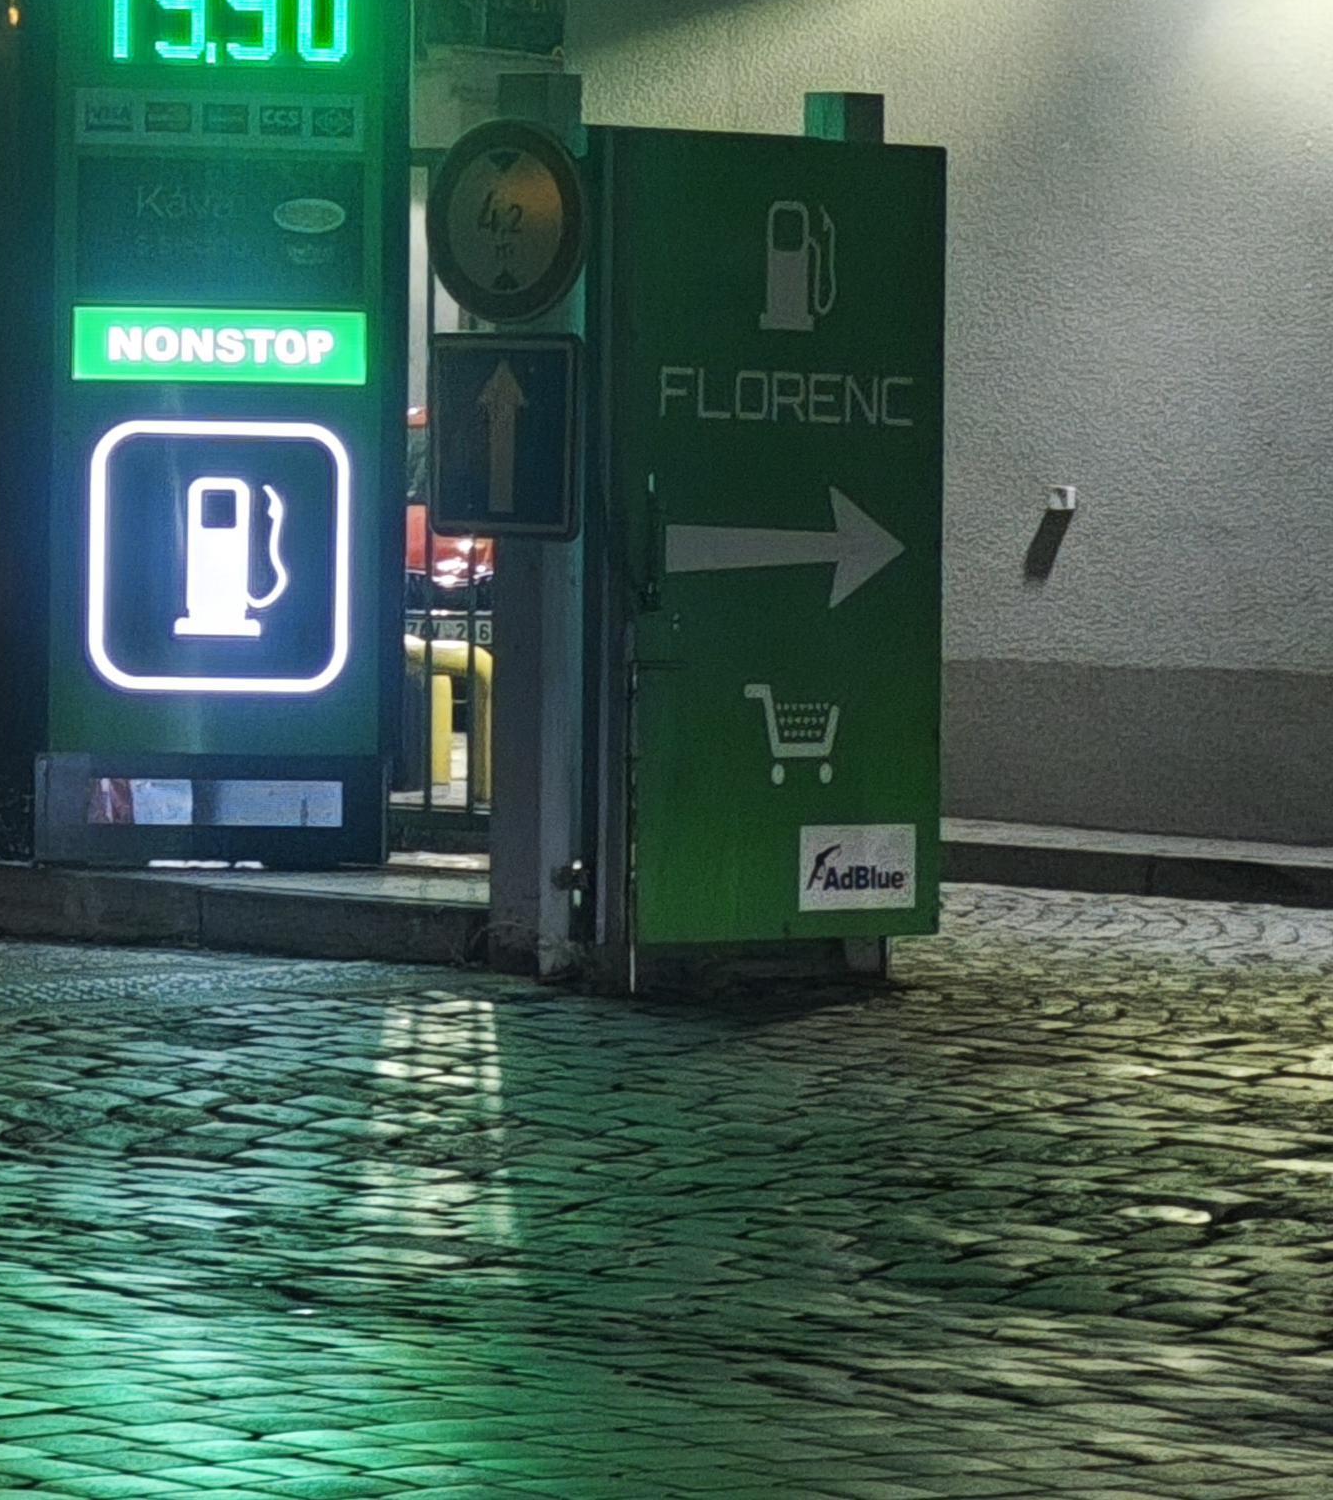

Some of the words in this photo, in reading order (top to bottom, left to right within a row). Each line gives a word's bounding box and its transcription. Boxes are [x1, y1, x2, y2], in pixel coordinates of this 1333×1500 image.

[263, 108, 300, 128] CCS
[108, 326, 334, 365] NONSTOP
[660, 366, 913, 426] FLORENC
[823, 865, 904, 891] AdBlue
